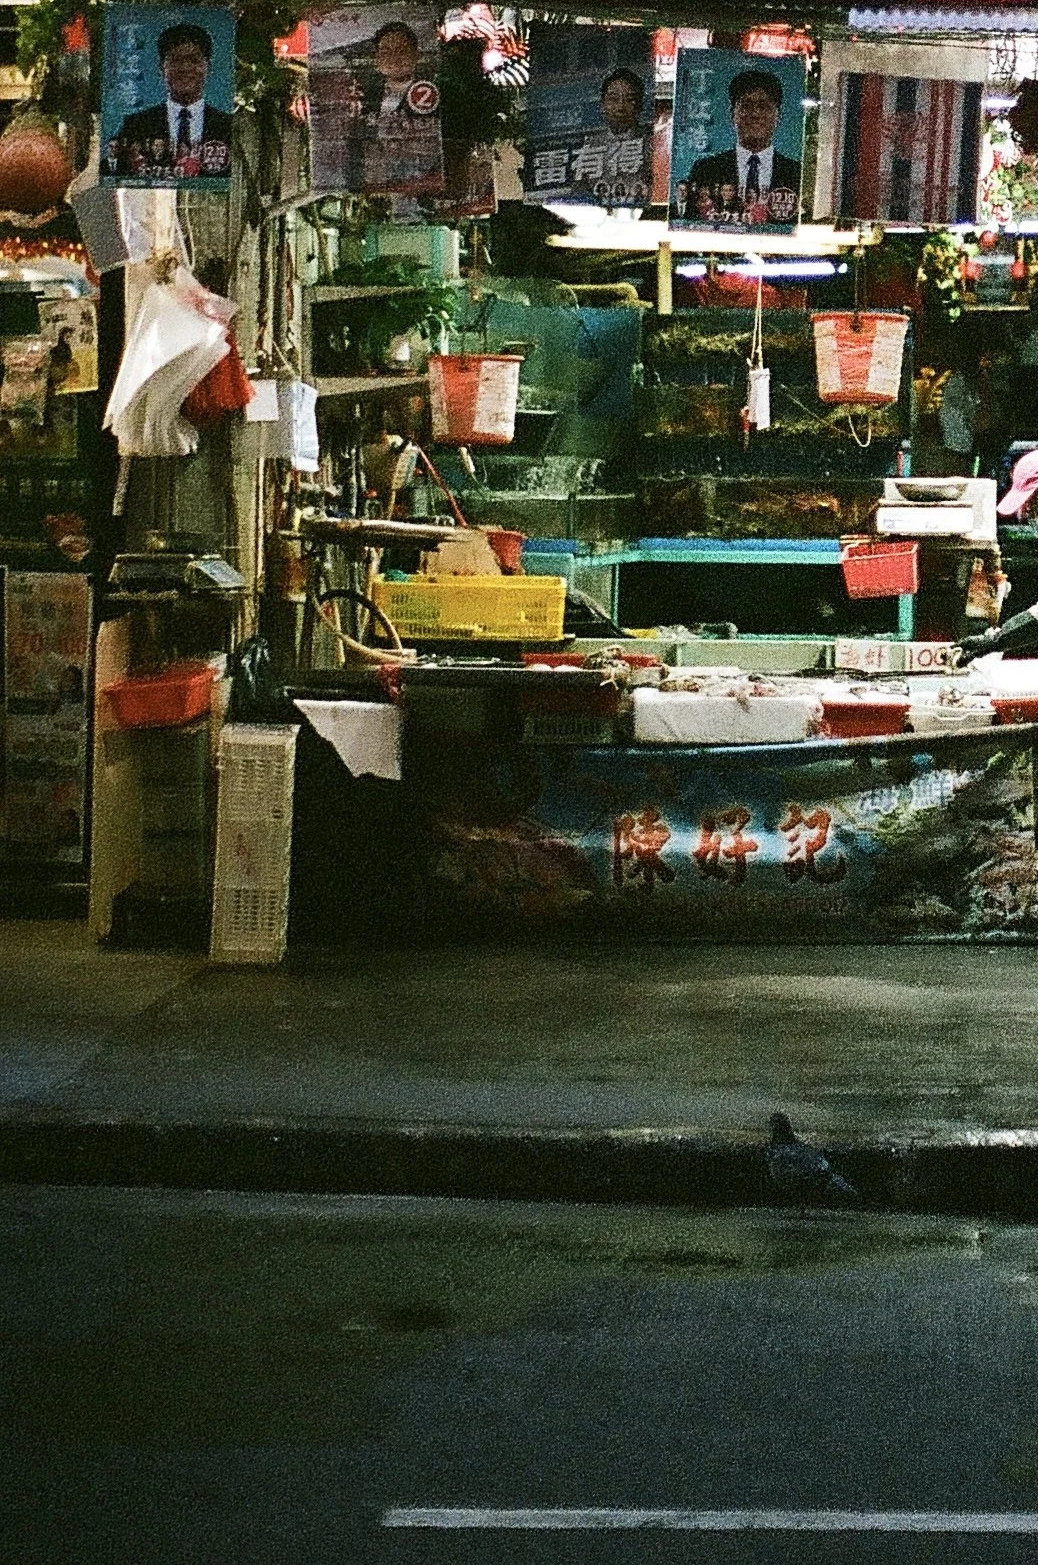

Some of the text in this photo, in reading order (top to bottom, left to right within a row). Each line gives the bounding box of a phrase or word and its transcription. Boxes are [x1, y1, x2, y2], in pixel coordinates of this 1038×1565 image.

[417, 87, 432, 105] 2
[612, 803, 849, 891] 陳好記
